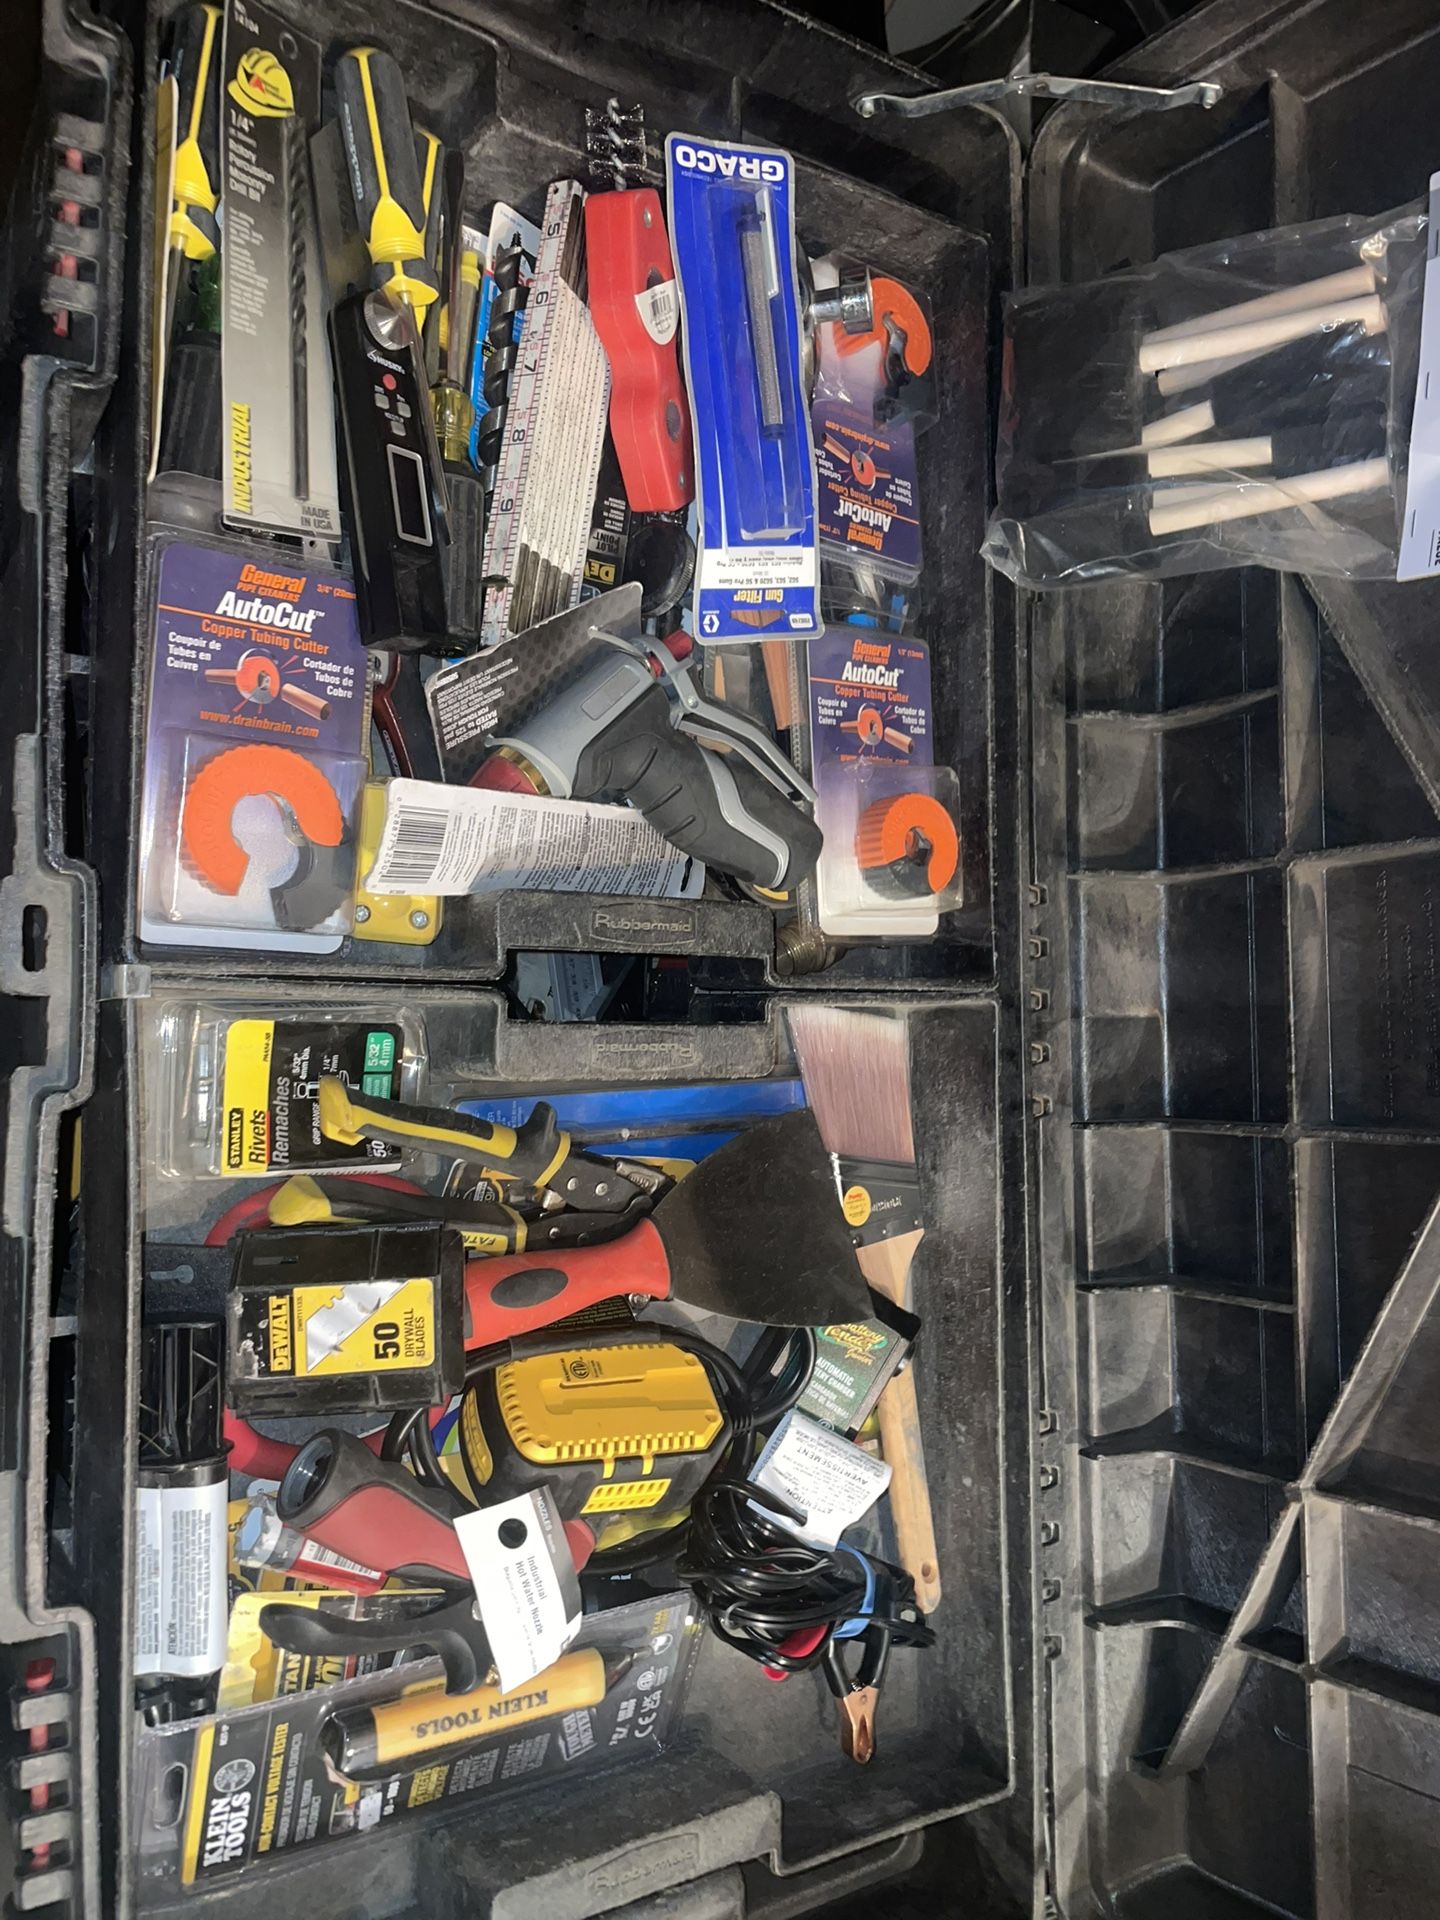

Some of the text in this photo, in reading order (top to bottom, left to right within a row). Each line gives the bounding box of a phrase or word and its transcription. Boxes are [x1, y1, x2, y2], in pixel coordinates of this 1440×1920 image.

[228, 138, 257, 165] Rotary
[675, 144, 785, 182] GRACO
[228, 164, 266, 195] Masonry
[547, 222, 561, 237] 5
[535, 291, 549, 305] 6
[375, 354, 405, 375] HUSKY
[524, 359, 537, 373] 7
[512, 429, 525, 442] 8
[230, 400, 253, 515] INDUSTRIAL
[827, 481, 898, 514] Copper Tubing Cutter
[301, 505, 330, 519] MADE
[300, 515, 334, 531] IN USA
[595, 540, 620, 553] PILOT
[847, 528, 882, 551] General
[239, 563, 307, 594] General
[236, 582, 301, 603] PIPE CLEANERS
[733, 589, 784, 604] Gun Filter
[168, 631, 222, 651] Coupoir de
[201, 618, 330, 655] Copper Tubing Cutter
[168, 644, 212, 662] Tubes en
[851, 638, 892, 658] General
[167, 656, 199, 672] Cuivre
[302, 657, 355, 676] Cortador de
[314, 671, 354, 688] Tubos de
[326, 684, 354, 699] Cobre
[834, 684, 910, 704] Copper Tubing Cutter
[818, 706, 836, 717] Tubes
[840, 699, 848, 709] de
[894, 705, 926, 717] Cortador de
[199, 709, 321, 739] www.drainbrain.com
[457, 712, 479, 727] TOUGH
[474, 709, 498, 727] RATED
[902, 715, 926, 726] Tubos de
[444, 716, 499, 751] HIGH PRESSURE
[454, 726, 467, 737] 125
[909, 724, 927, 736] Cobre
[595, 913, 692, 932] Rubbermaid
[597, 1042, 696, 1059] Rubbermaid
[299, 1046, 312, 1080] 4mm Dia.
[322, 1055, 331, 1070] 1/4"
[330, 1054, 339, 1073] 7mm
[272, 1076, 291, 1164] Remaches
[312, 1101, 321, 1146] GRIP RANGE
[229, 1110, 243, 1166] STANLEY
[249, 1109, 266, 1165] Rivets
[371, 1140, 387, 1158] 50
[373, 1322, 400, 1360] 50
[404, 1308, 415, 1358] DRYWALL
[415, 1316, 426, 1357] BLADES
[824, 1325, 873, 1352] Tender
[815, 1356, 855, 1387] AUTOMATIC
[827, 1377, 856, 1399] CHARGER
[797, 1446, 869, 1486] AVERTISSEMENT
[527, 1555, 548, 1601] Industrial
[516, 1561, 544, 1636] Hot Water Nozzle
[487, 1689, 549, 1720] KLEIN
[562, 1712, 583, 1755] TOUGH
[575, 1708, 595, 1748] METER
[288, 1732, 304, 1767] CONTACTO
[257, 1721, 290, 1853] NON-CONTACT VOLTAGE TESTER
[203, 1797, 231, 1868] KLEIN
[223, 1790, 252, 1862] TOOLS
